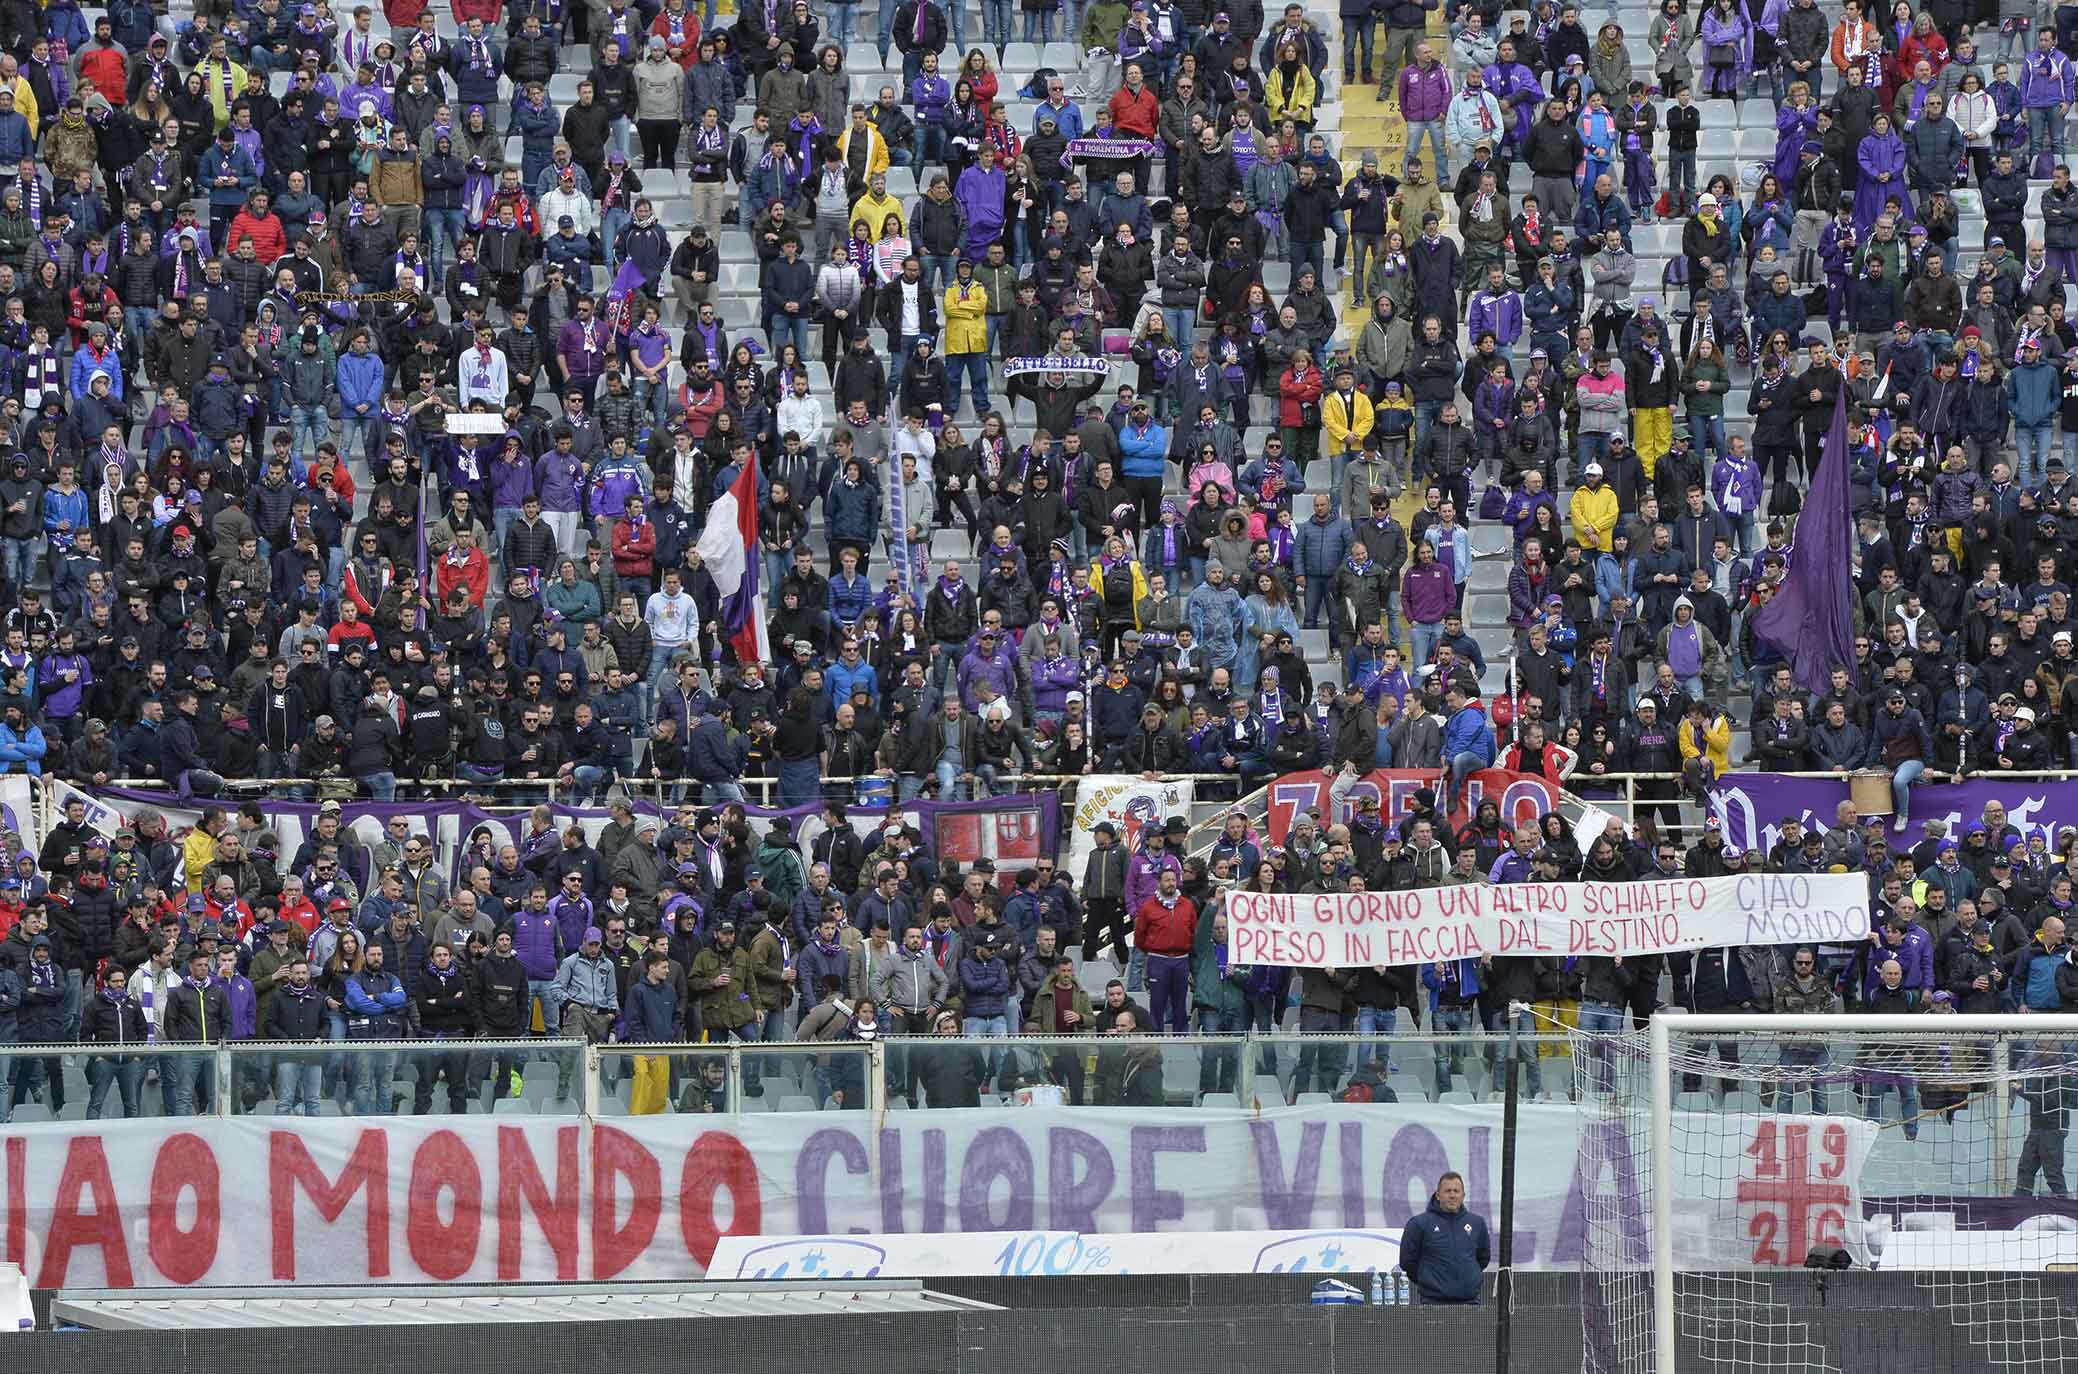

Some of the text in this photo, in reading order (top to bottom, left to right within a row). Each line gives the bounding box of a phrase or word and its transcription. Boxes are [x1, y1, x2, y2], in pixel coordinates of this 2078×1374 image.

[1084, 144, 1129, 154] FIORENTINA
[1386, 133, 1401, 143] 22
[1390, 163, 1403, 173] 21
[1003, 357, 1106, 373] SETTE BELLO
[1230, 880, 1707, 925] OGNI GIORNO UN ALTRO SCHIAFFO
[1736, 874, 1811, 912] CIAO
[1235, 913, 1704, 964] PRESO IN FACCIA DAL DESTINO...
[1745, 906, 1868, 944] MONDO
[269, 1123, 762, 1282] MONDO
[796, 1126, 1207, 1235] CUORE
[1248, 1121, 1651, 1264] VIOLA
